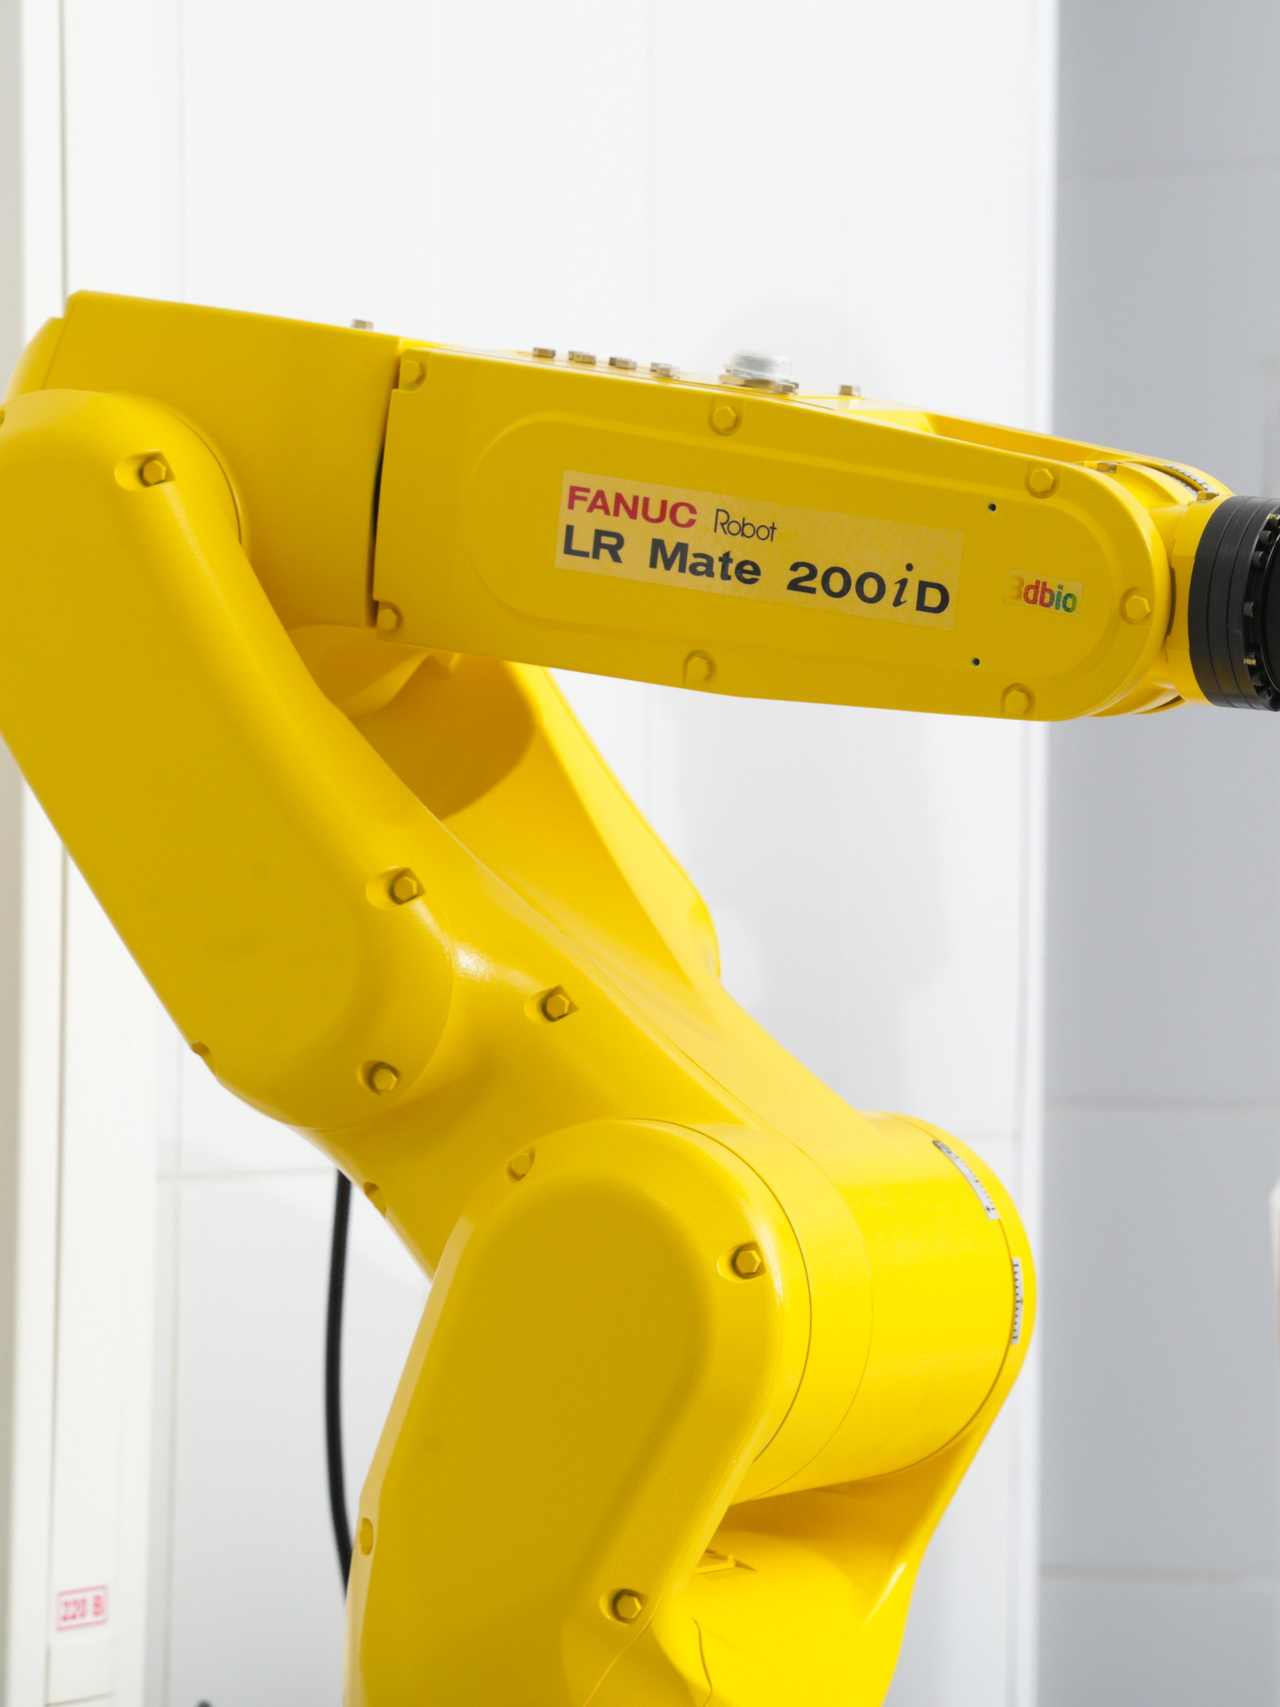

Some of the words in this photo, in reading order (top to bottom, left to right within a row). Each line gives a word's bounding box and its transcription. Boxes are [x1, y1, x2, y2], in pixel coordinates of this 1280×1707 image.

[567, 485, 698, 529] FANUC
[713, 508, 778, 542] Robot
[563, 524, 625, 564] LR
[649, 537, 762, 585] Mate
[786, 561, 950, 614] 200iD
[1008, 575, 1078, 613] 3dbio
